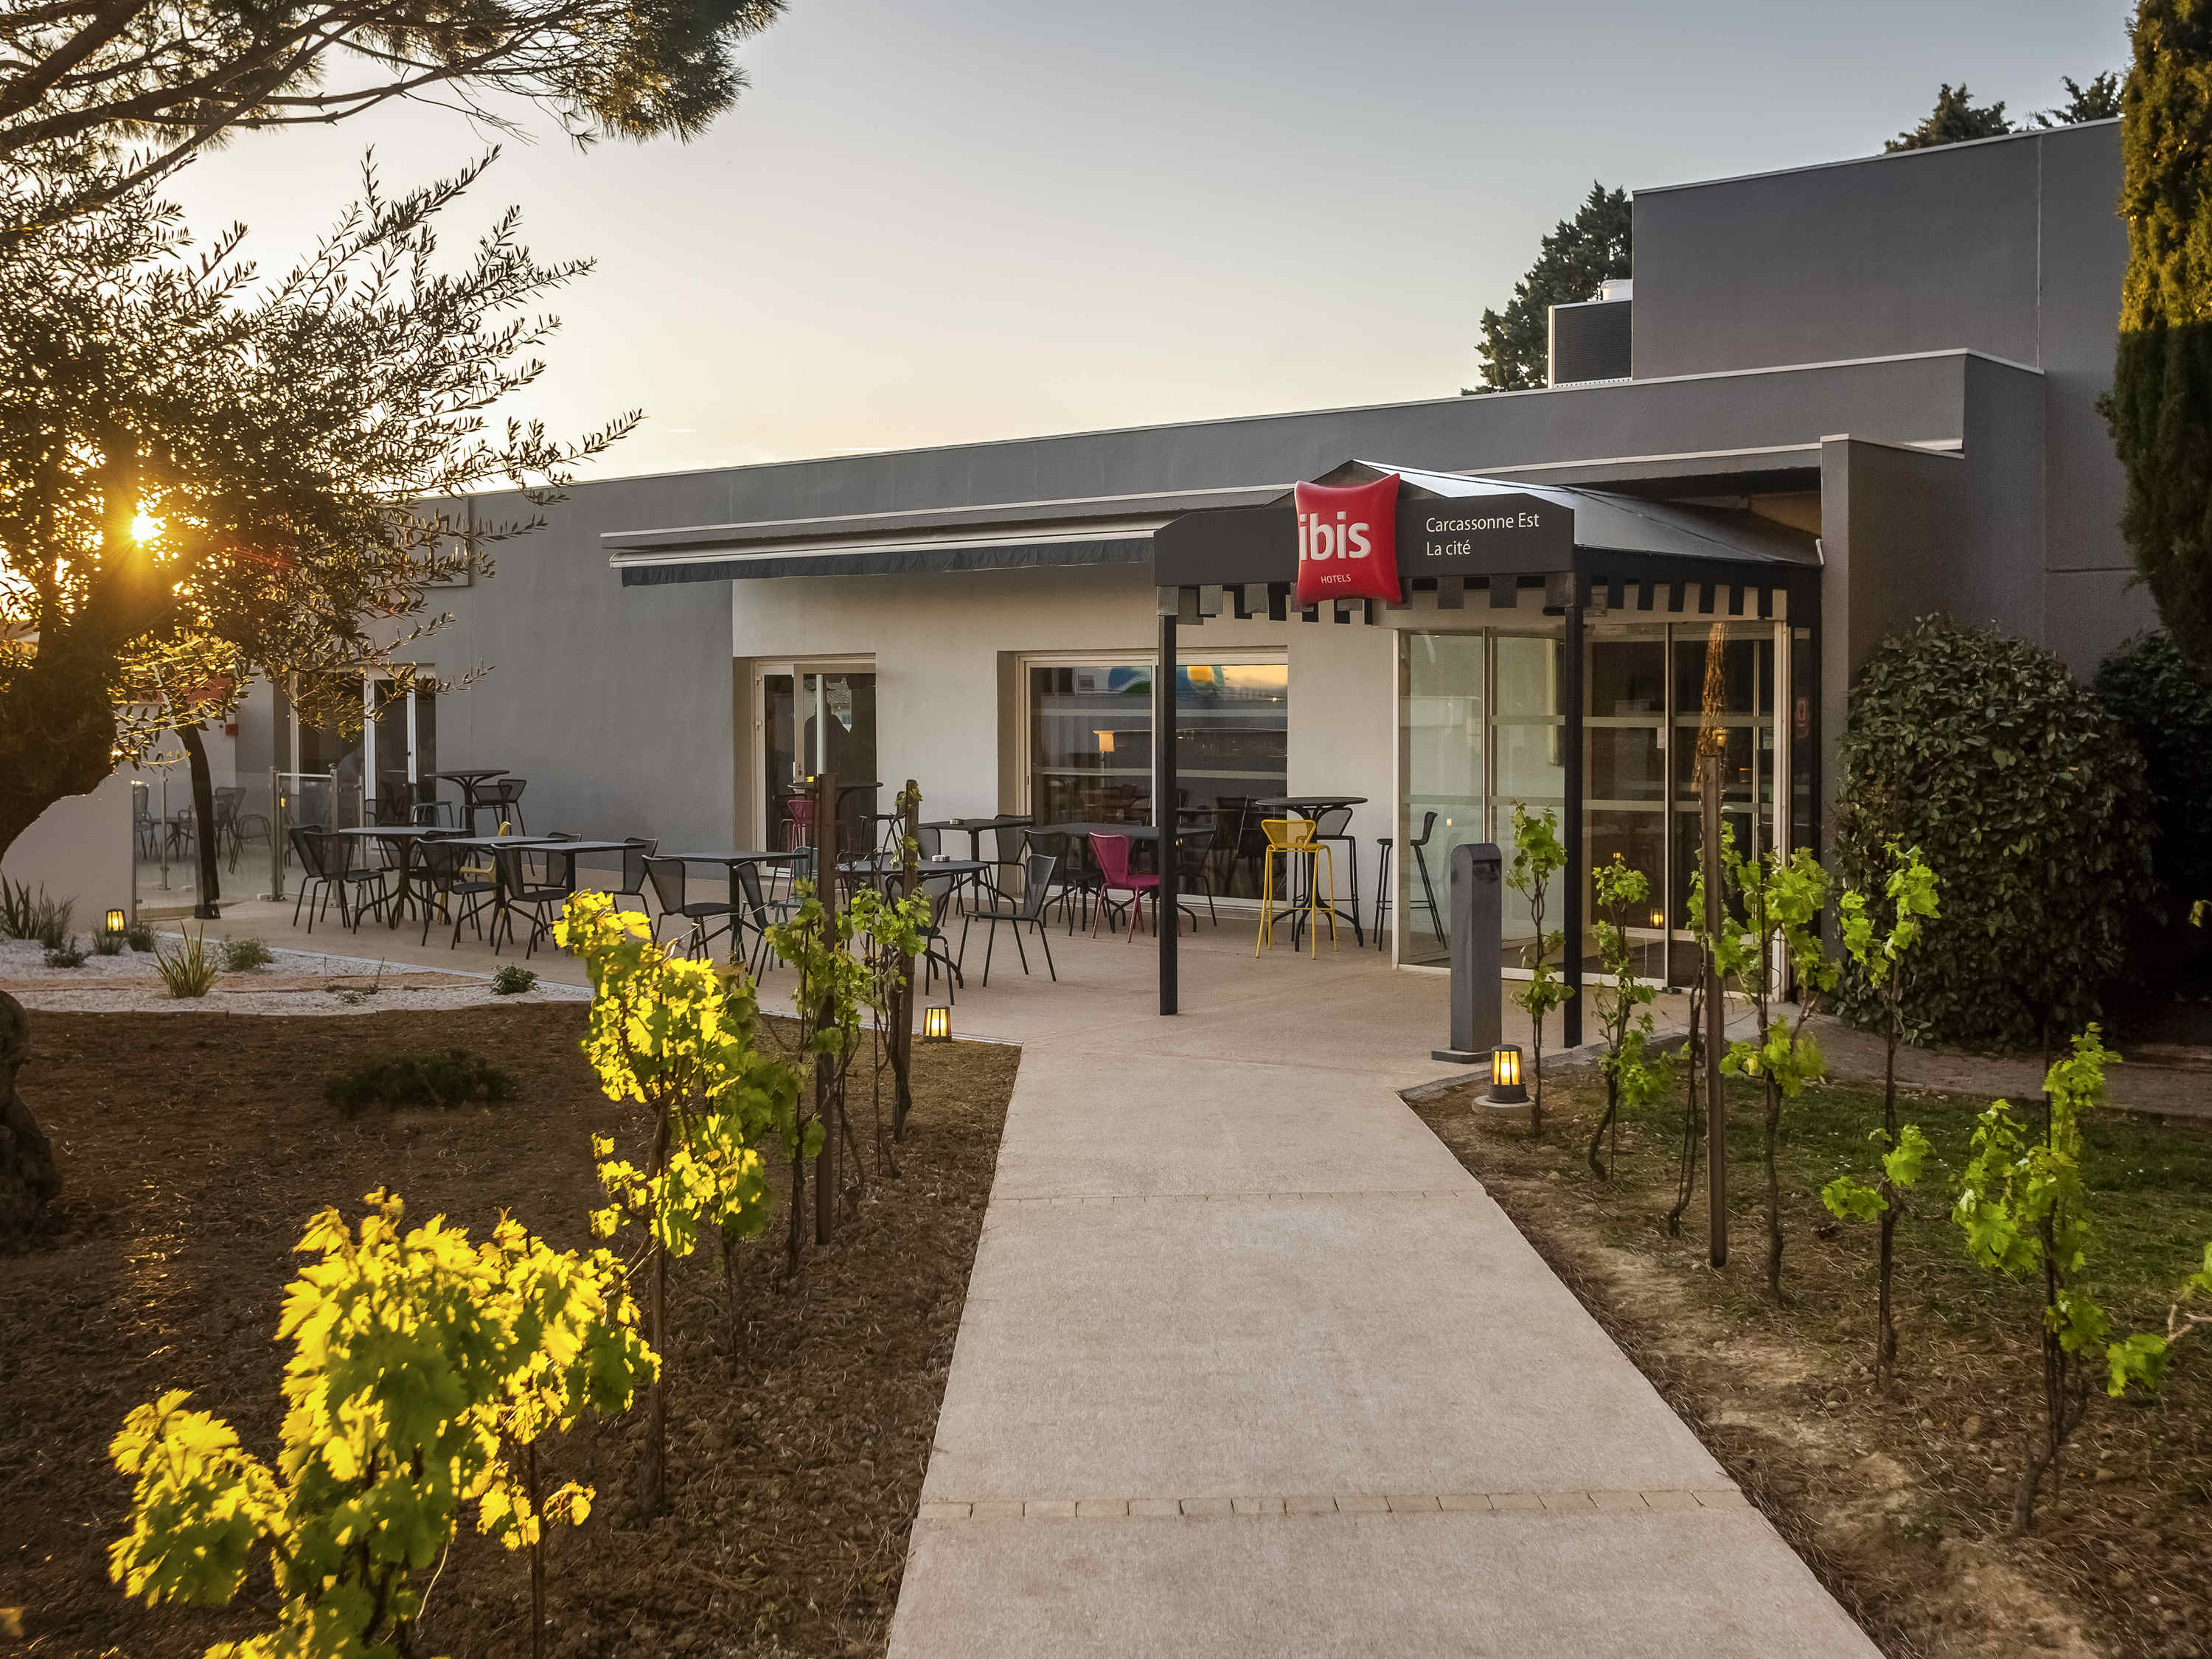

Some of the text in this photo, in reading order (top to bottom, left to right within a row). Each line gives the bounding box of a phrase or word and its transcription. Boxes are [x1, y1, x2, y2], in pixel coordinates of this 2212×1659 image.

[1426, 512, 1540, 532] Carcassonne Est
[1299, 511, 1371, 561] ibis
[1427, 539, 1471, 556] La cité
[1321, 574, 1352, 584] HOTELS
